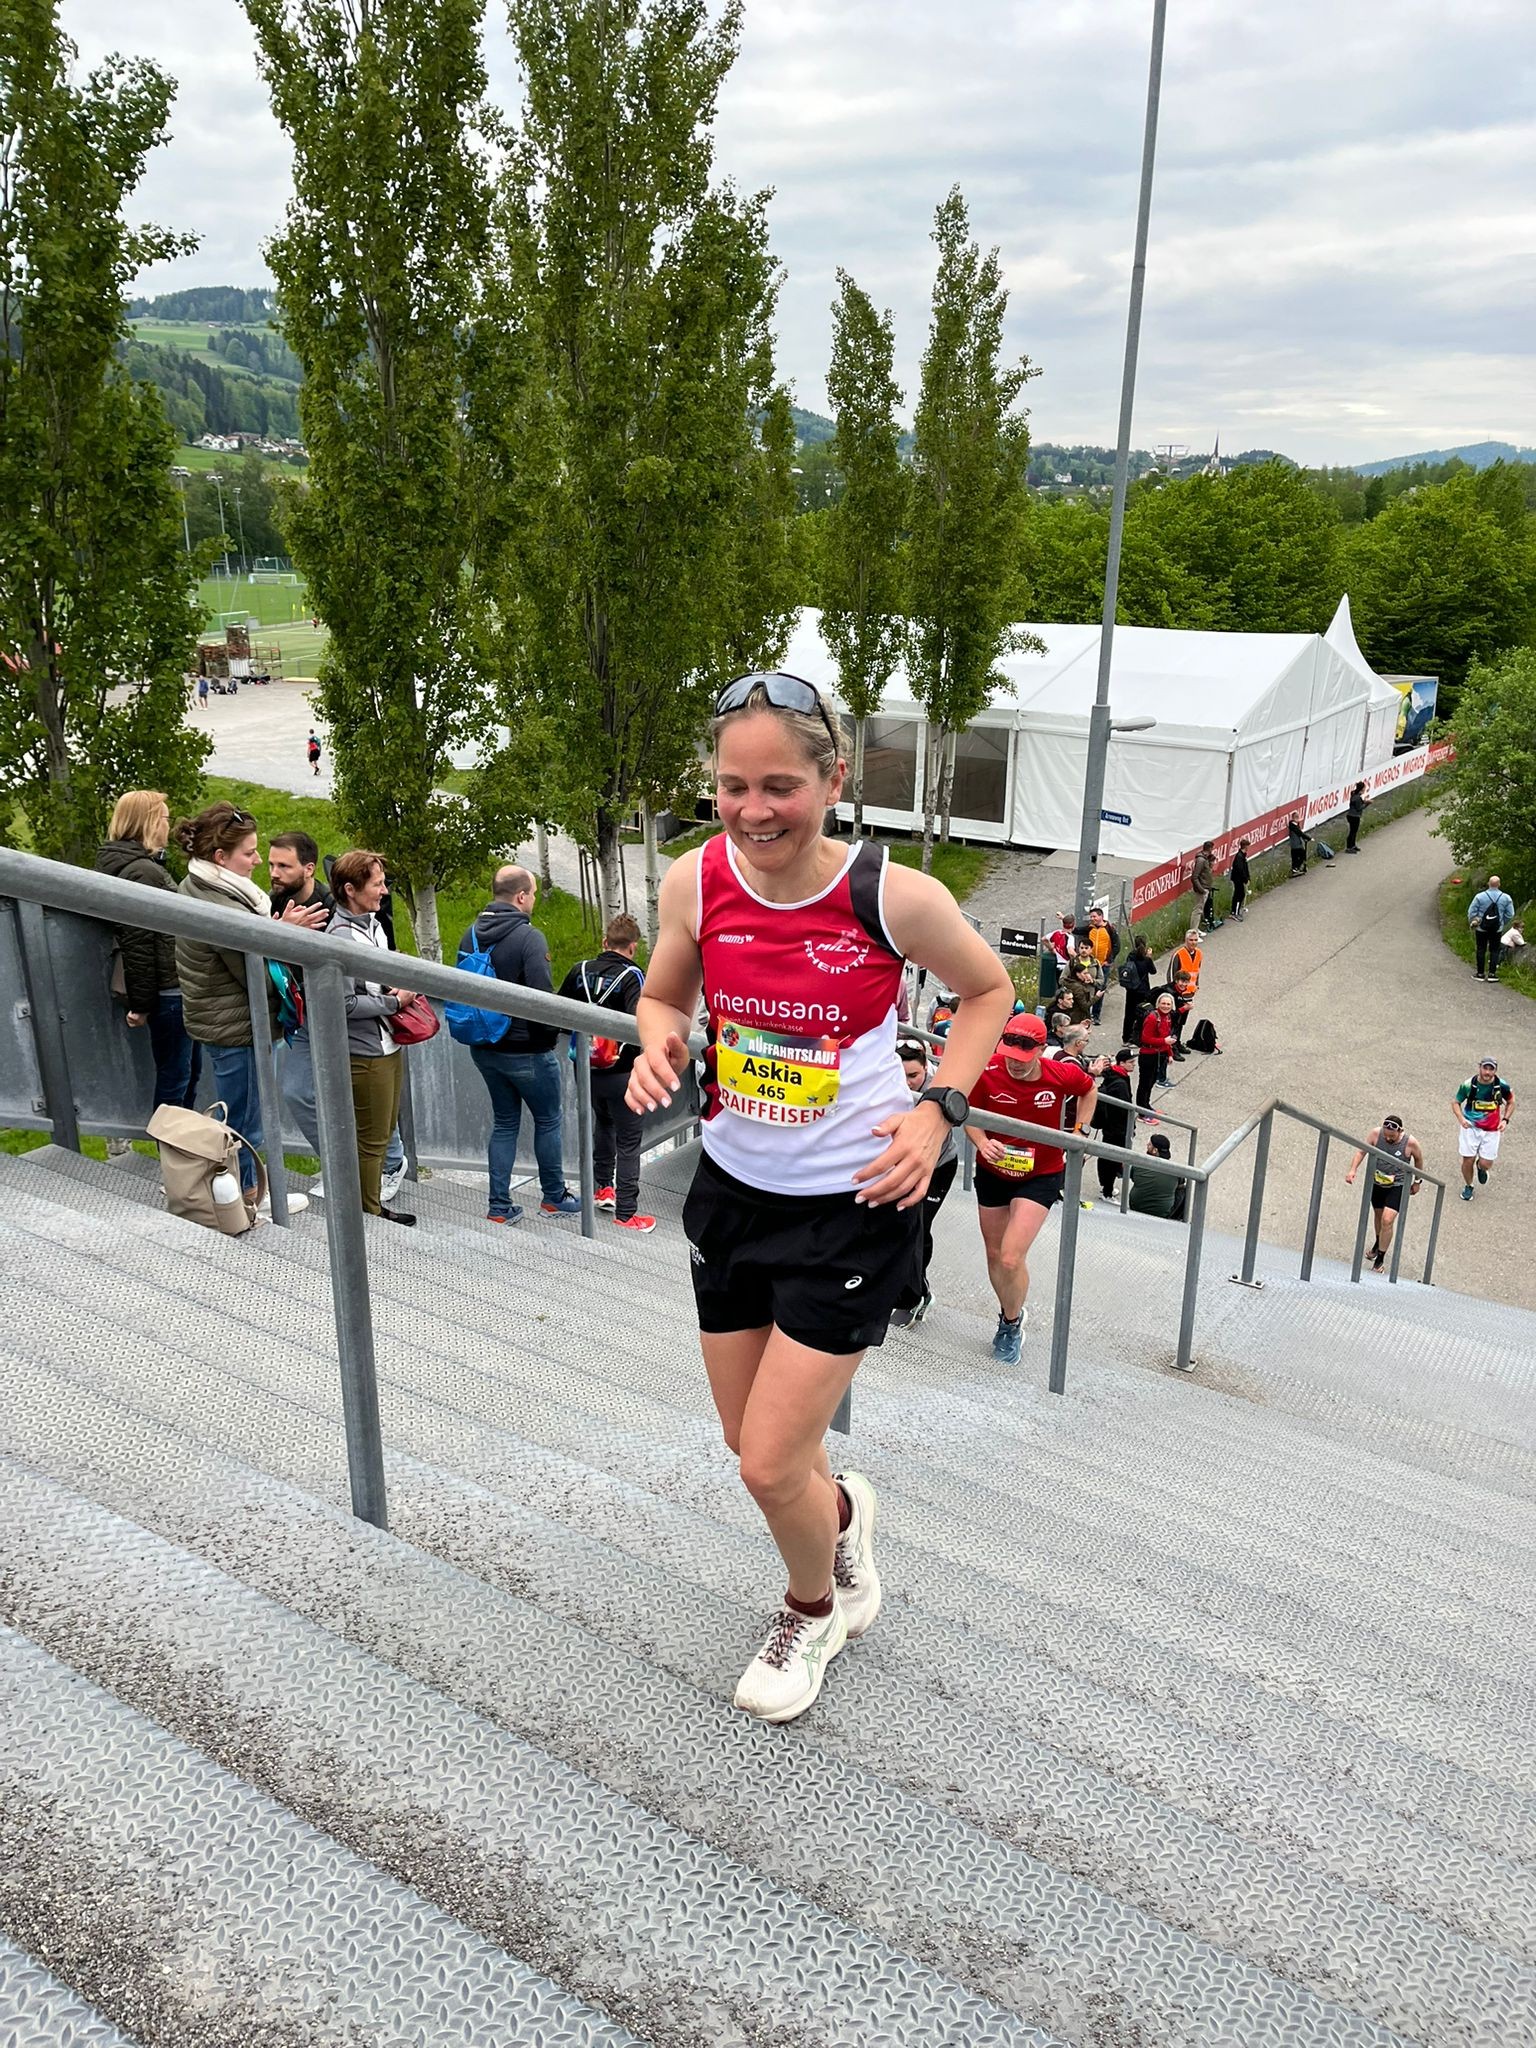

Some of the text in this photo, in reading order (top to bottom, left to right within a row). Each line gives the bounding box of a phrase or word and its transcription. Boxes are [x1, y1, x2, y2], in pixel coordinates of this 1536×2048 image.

[1307, 790, 1340, 818] MIGROS
[1374, 763, 1401, 788] MIGROS
[1402, 754, 1426, 776] MIGROS
[1144, 866, 1182, 902] GENERALI
[804, 940, 870, 975] RHEINTAL
[815, 943, 860, 953] MILA
[1001, 939, 1037, 950] Garderoben
[754, 1019, 804, 1033] krankenkasse
[742, 1057, 802, 1086] Askia
[721, 1088, 825, 1124] RAIFFEISEN
[757, 1084, 786, 1101] 465
